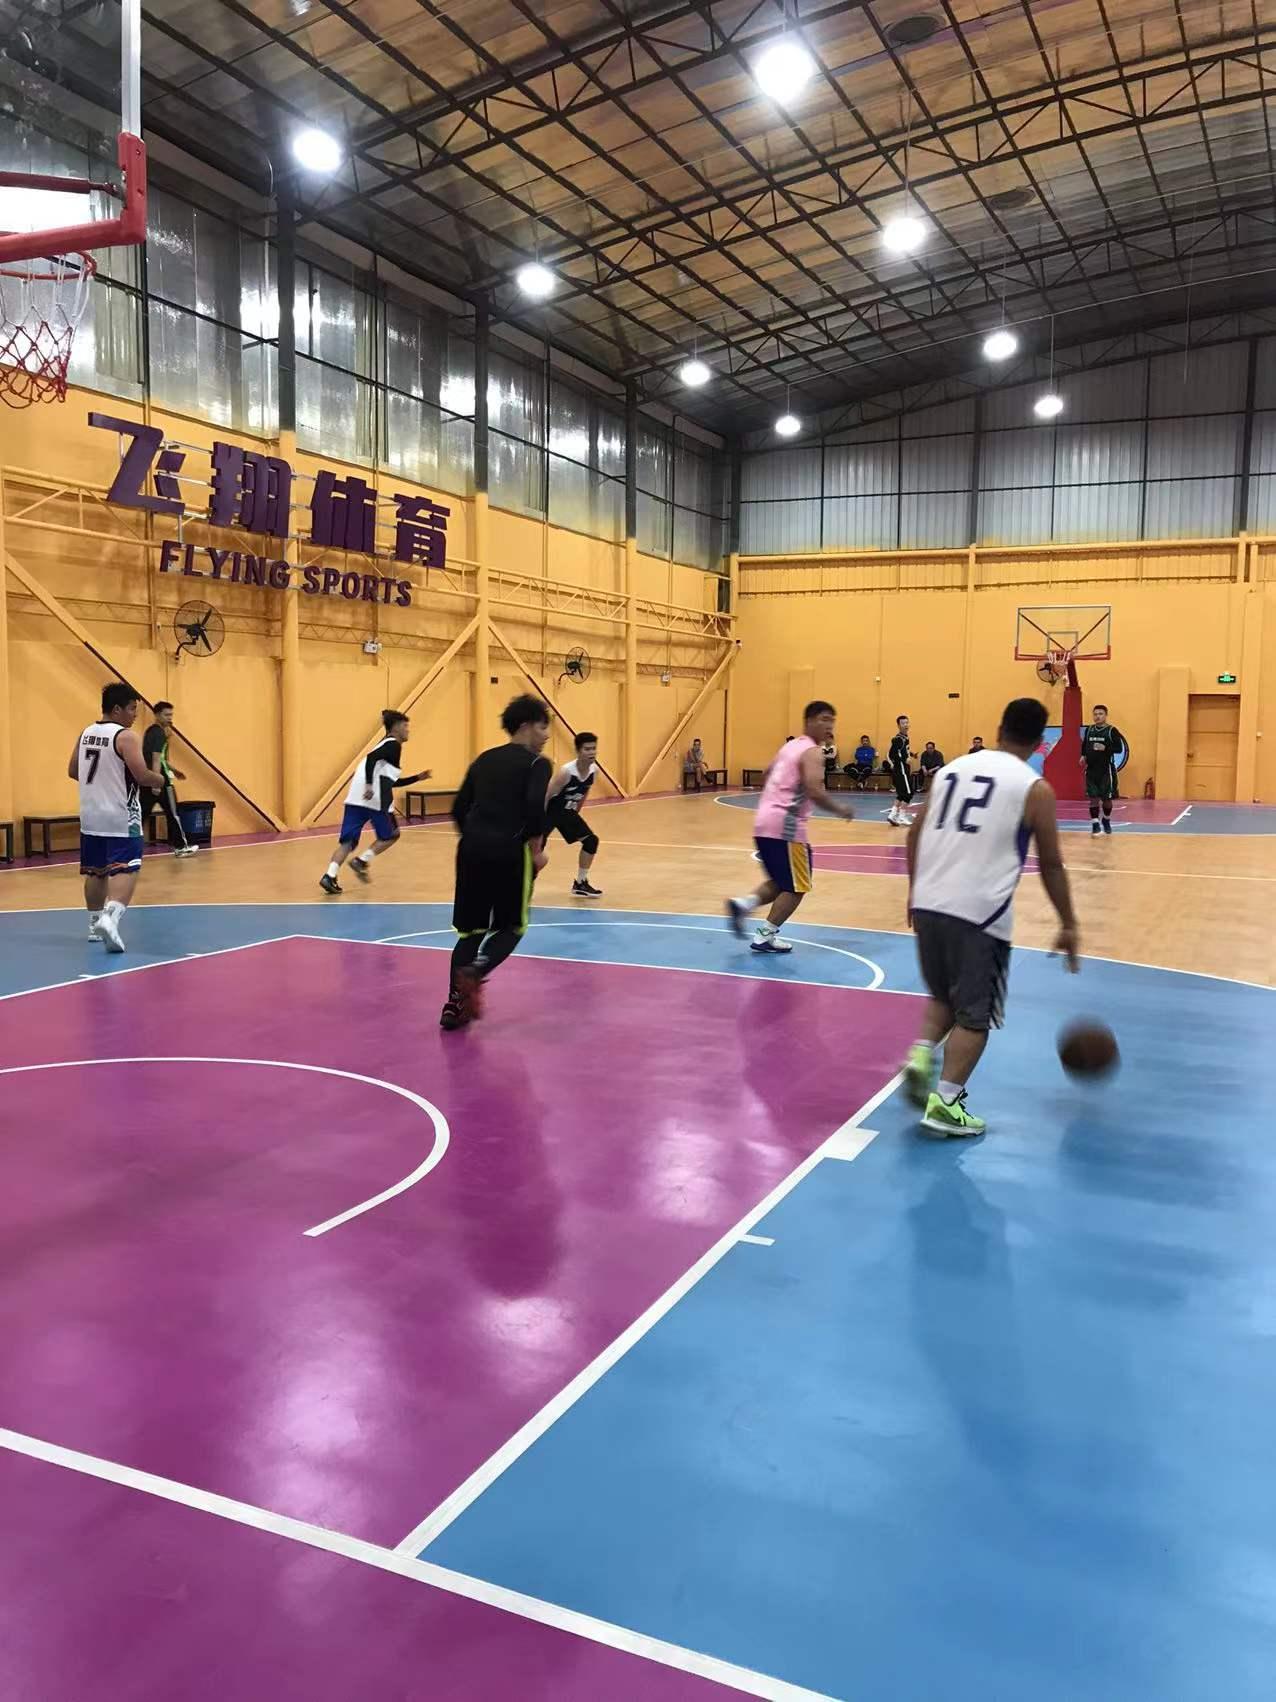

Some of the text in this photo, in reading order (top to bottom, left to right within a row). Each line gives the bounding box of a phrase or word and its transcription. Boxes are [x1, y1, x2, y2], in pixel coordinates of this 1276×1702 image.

[88, 412, 450, 569] 飞翔体育
[159, 540, 412, 606] FLYING SPORTS
[85, 747, 102, 784] 7
[935, 772, 996, 833] 12
